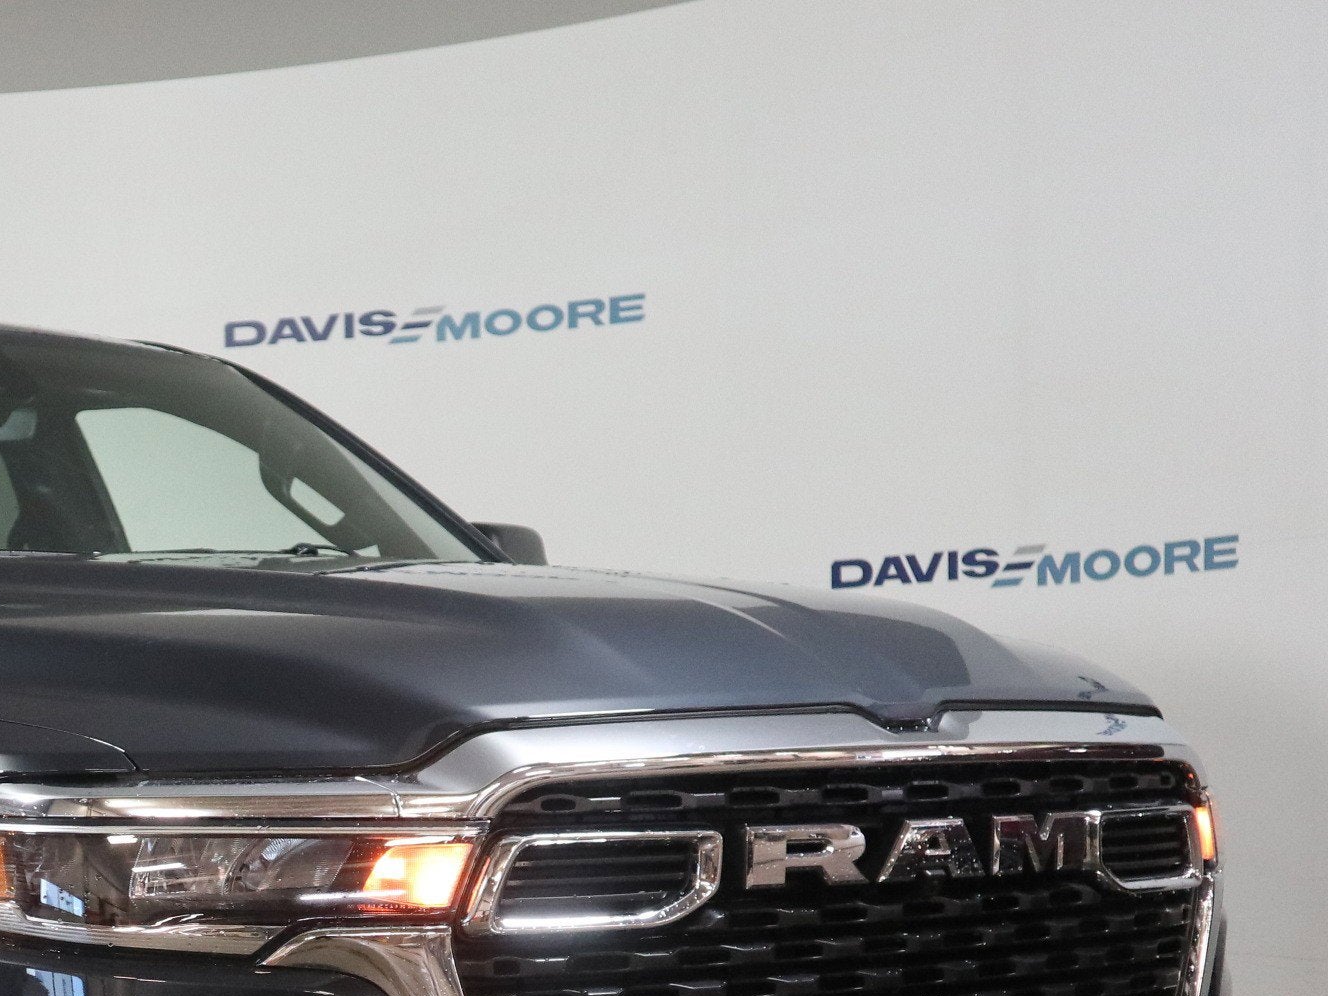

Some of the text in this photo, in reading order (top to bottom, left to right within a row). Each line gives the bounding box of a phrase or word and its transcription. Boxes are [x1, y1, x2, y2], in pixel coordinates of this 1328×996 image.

[224, 293, 647, 348] DAVIS MOORE
[830, 534, 1240, 590] DAVIS MOORE
[745, 811, 1102, 889] RAM
